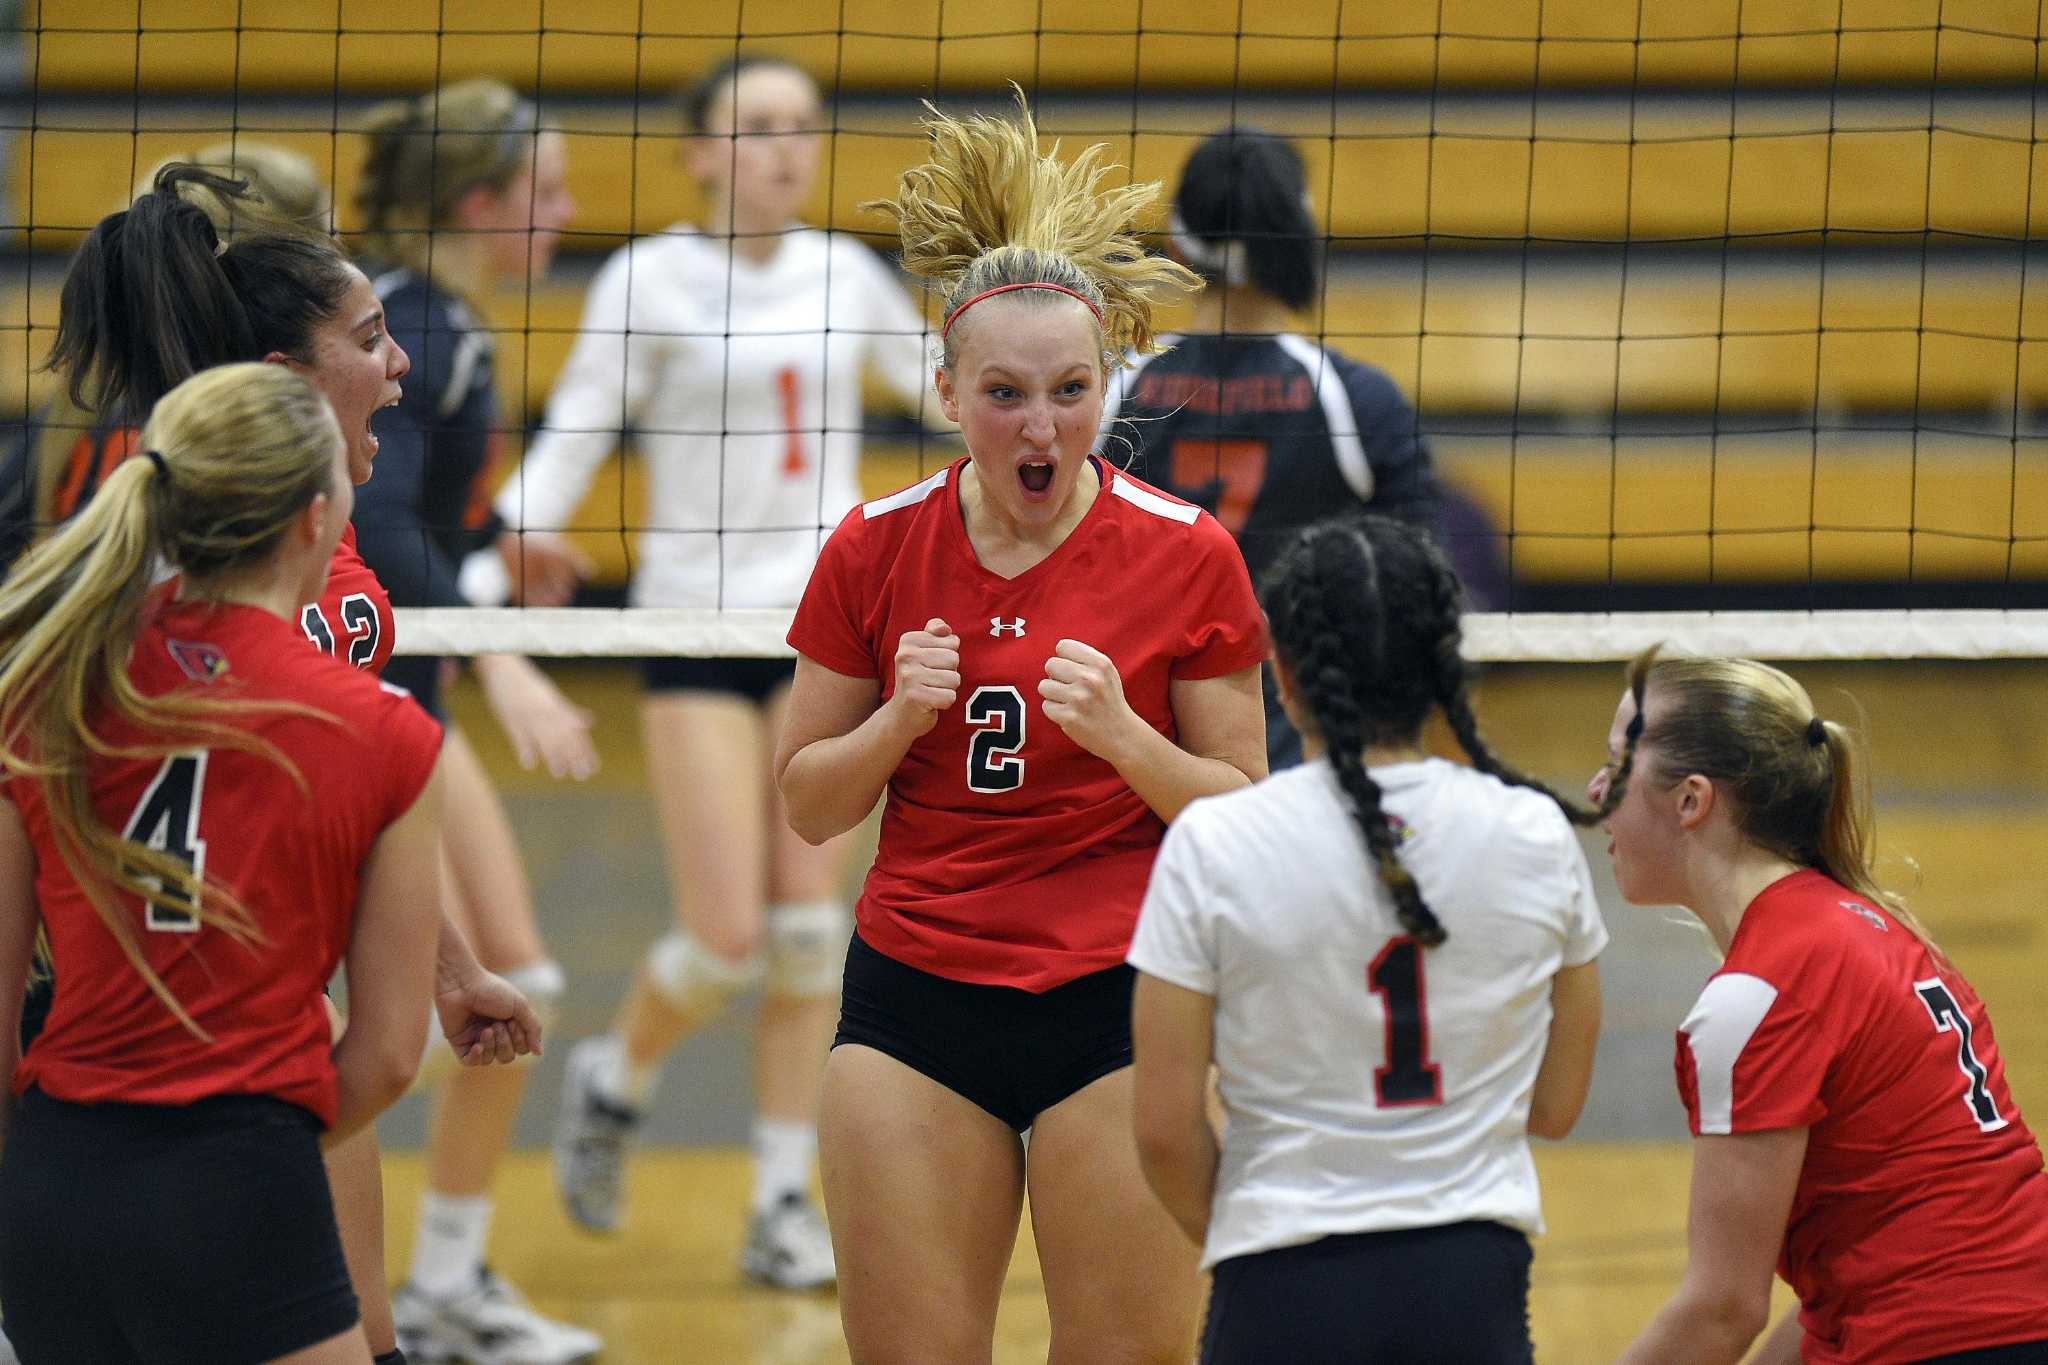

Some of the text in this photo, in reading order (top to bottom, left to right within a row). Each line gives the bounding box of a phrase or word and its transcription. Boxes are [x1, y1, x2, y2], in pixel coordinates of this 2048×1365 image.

[776, 366, 810, 478] 1
[1171, 437, 1267, 534] 7
[301, 592, 380, 671] 12
[965, 685, 1026, 794] 2
[121, 746, 209, 933] 4
[1366, 934, 1444, 1109] 1
[1913, 976, 2010, 1133] 7
